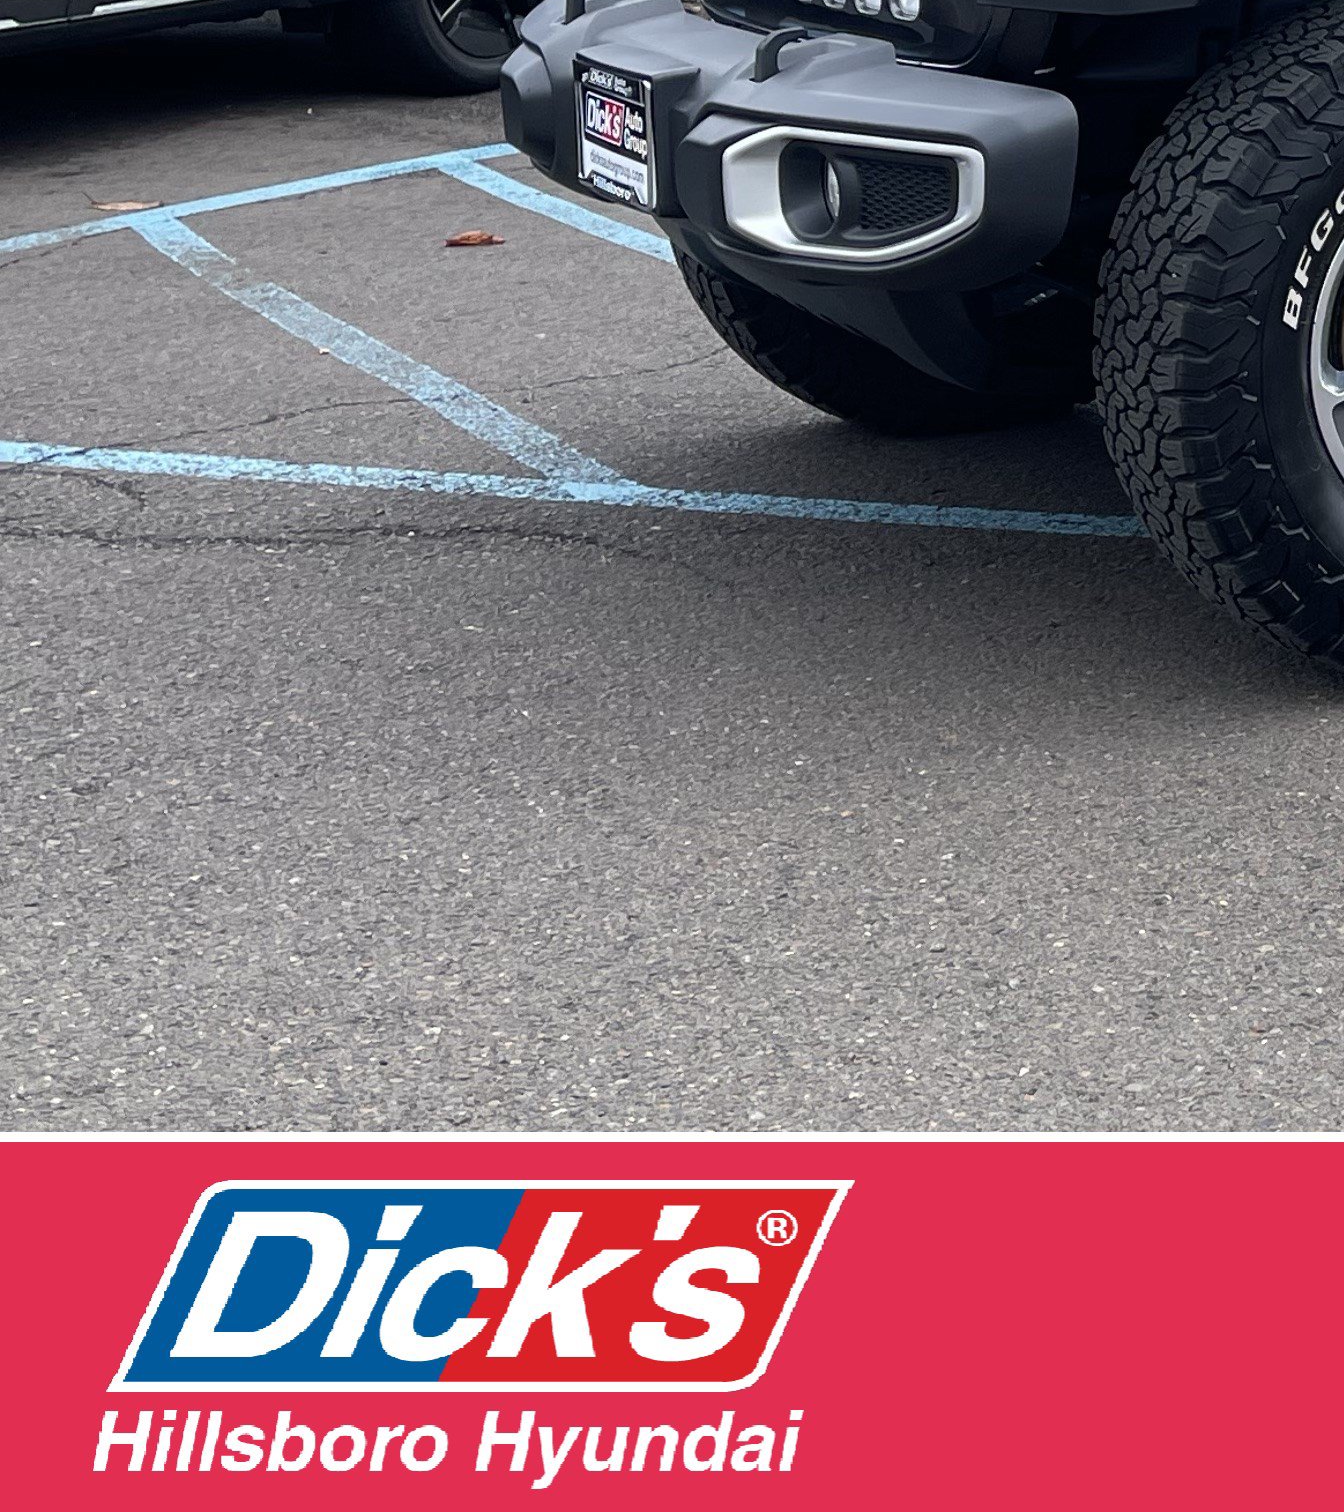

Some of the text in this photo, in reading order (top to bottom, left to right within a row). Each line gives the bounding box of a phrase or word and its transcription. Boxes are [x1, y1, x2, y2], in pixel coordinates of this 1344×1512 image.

[587, 97, 621, 140] Dick's
[625, 106, 644, 133] Auto
[624, 127, 648, 160] Group
